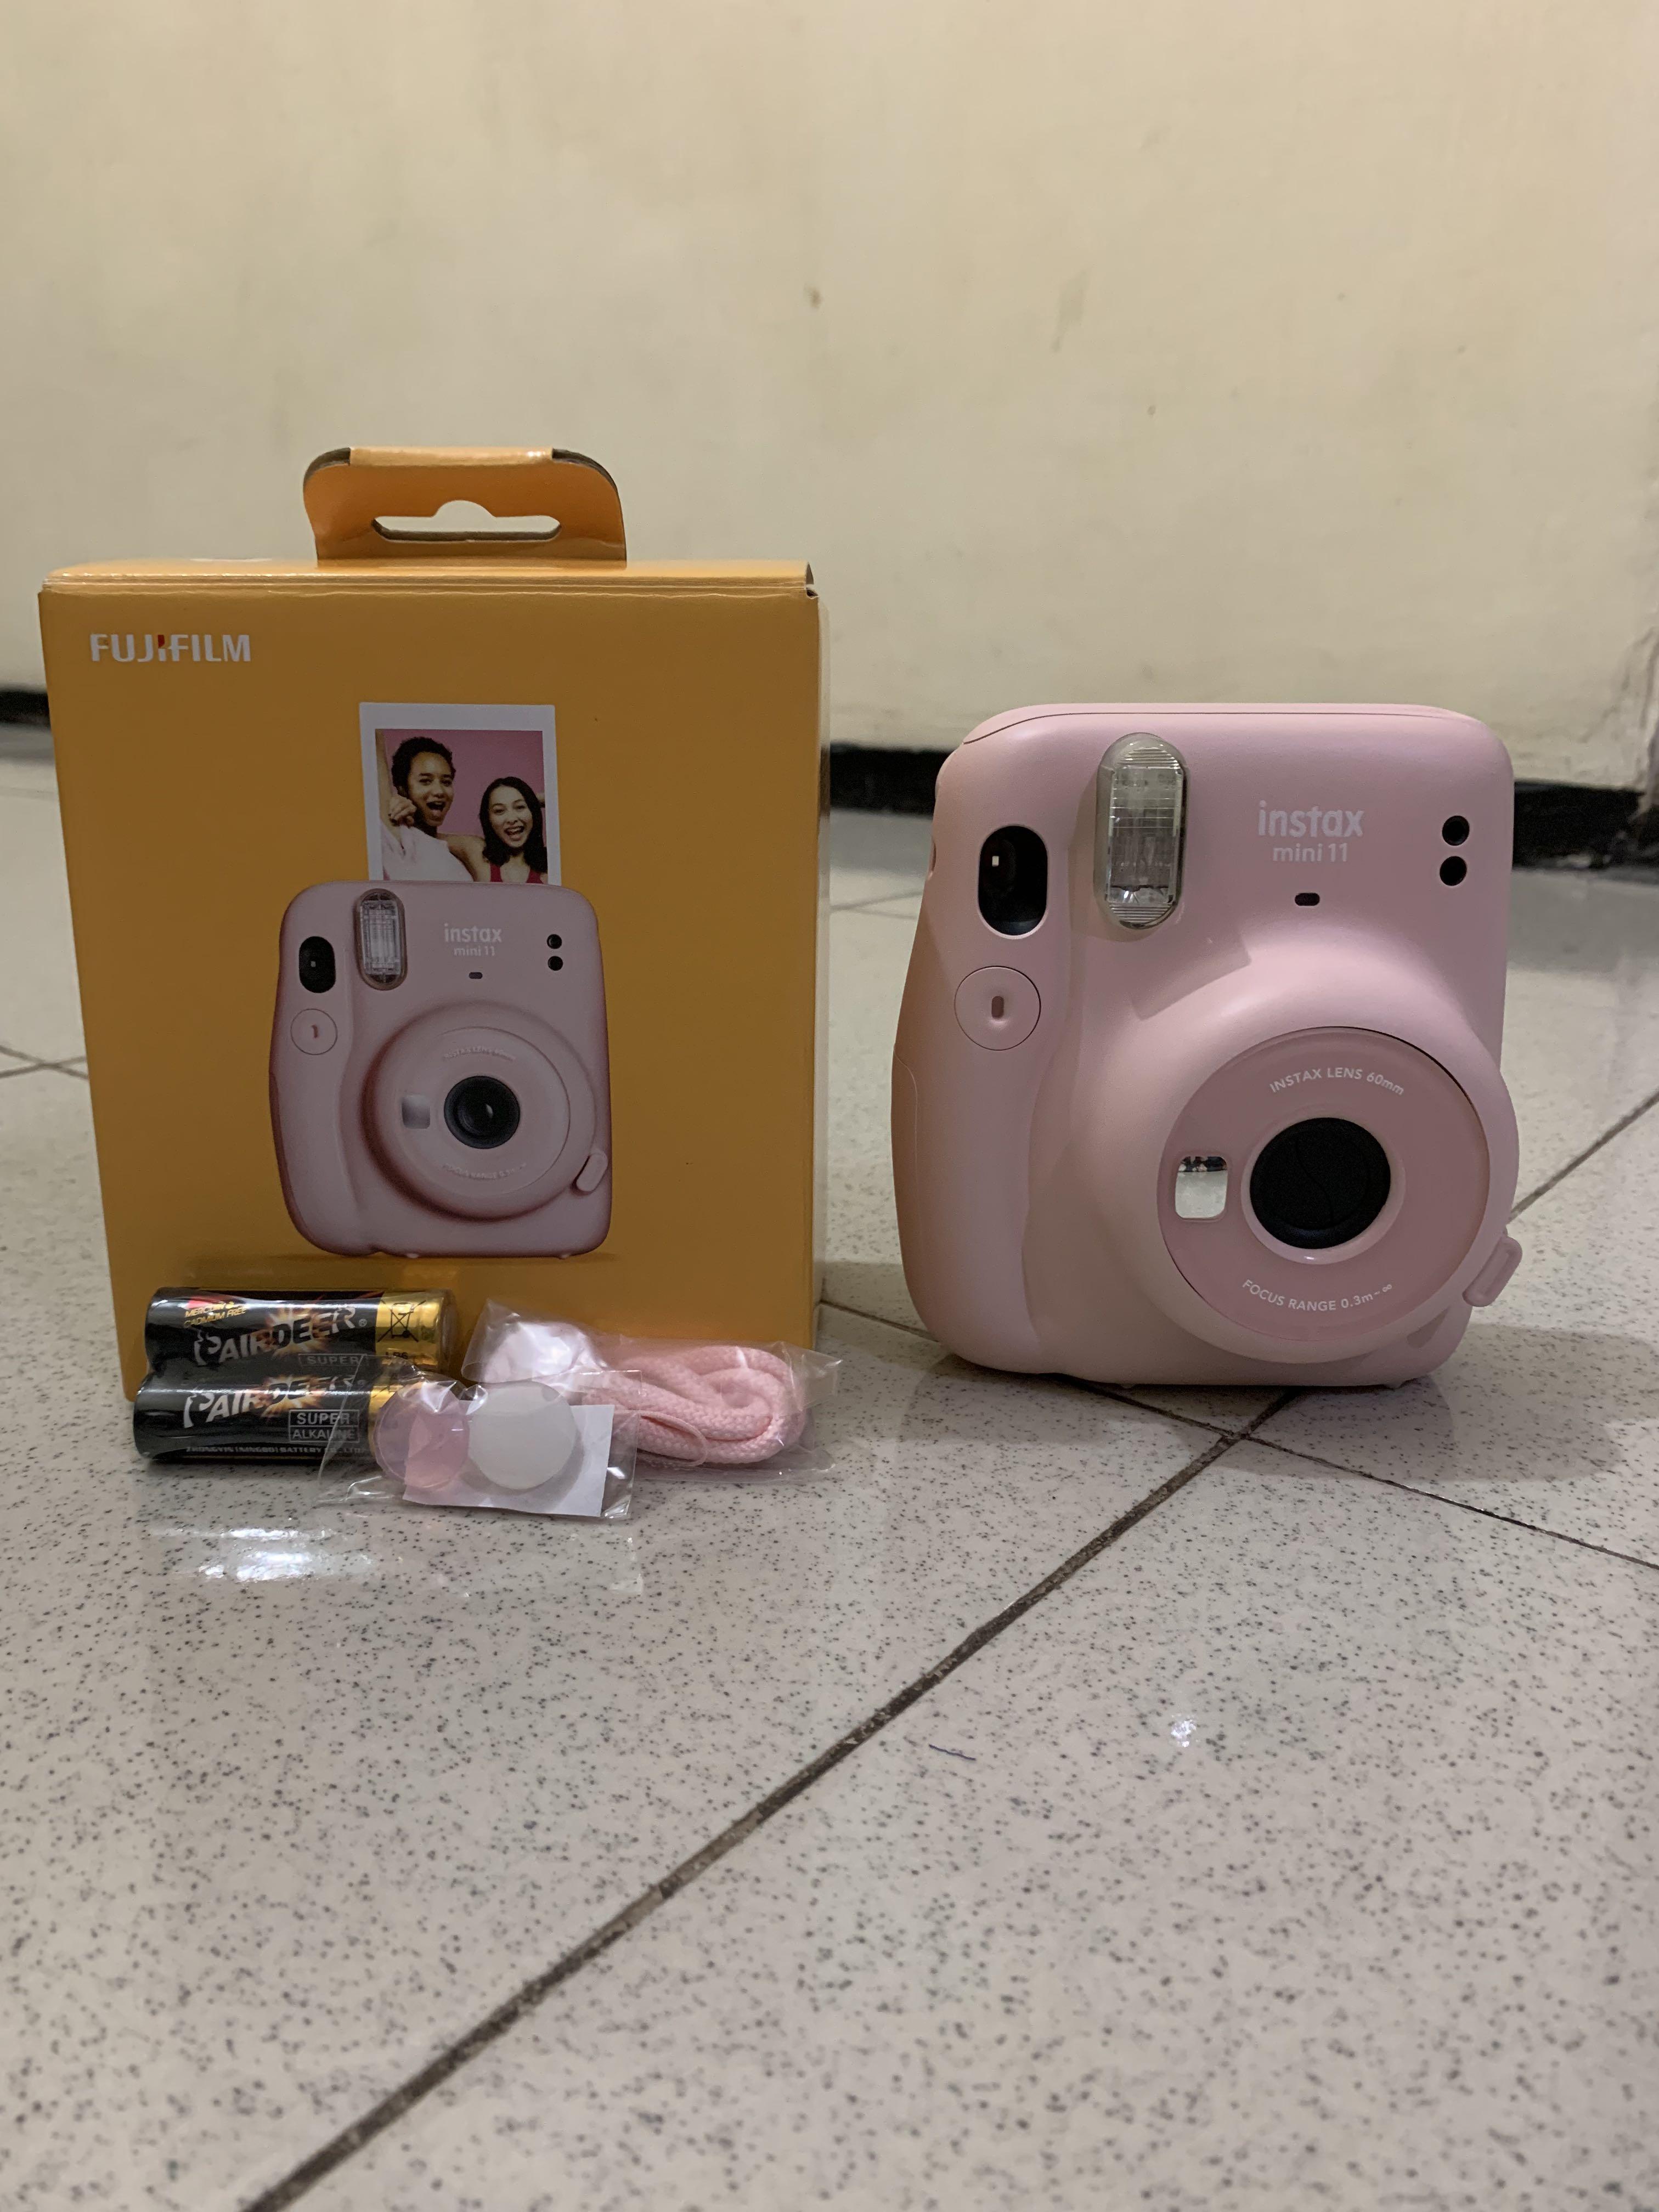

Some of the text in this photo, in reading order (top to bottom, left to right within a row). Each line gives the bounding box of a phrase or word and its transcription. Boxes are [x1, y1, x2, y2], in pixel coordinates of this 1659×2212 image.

[90, 634, 251, 662] FUJIFILM
[1257, 800, 1364, 838] instax
[1273, 843, 1348, 862] mini 11
[444, 923, 502, 943] instax
[454, 945, 495, 956] mini 11
[1269, 1067, 1404, 1096] INSTAX LENS 60mm
[1242, 1279, 1285, 1306] FOCUS
[1288, 1299, 1336, 1311] RANGE
[306, 1356, 358, 1365] SUPER
[297, 1412, 351, 1425] SUPER
